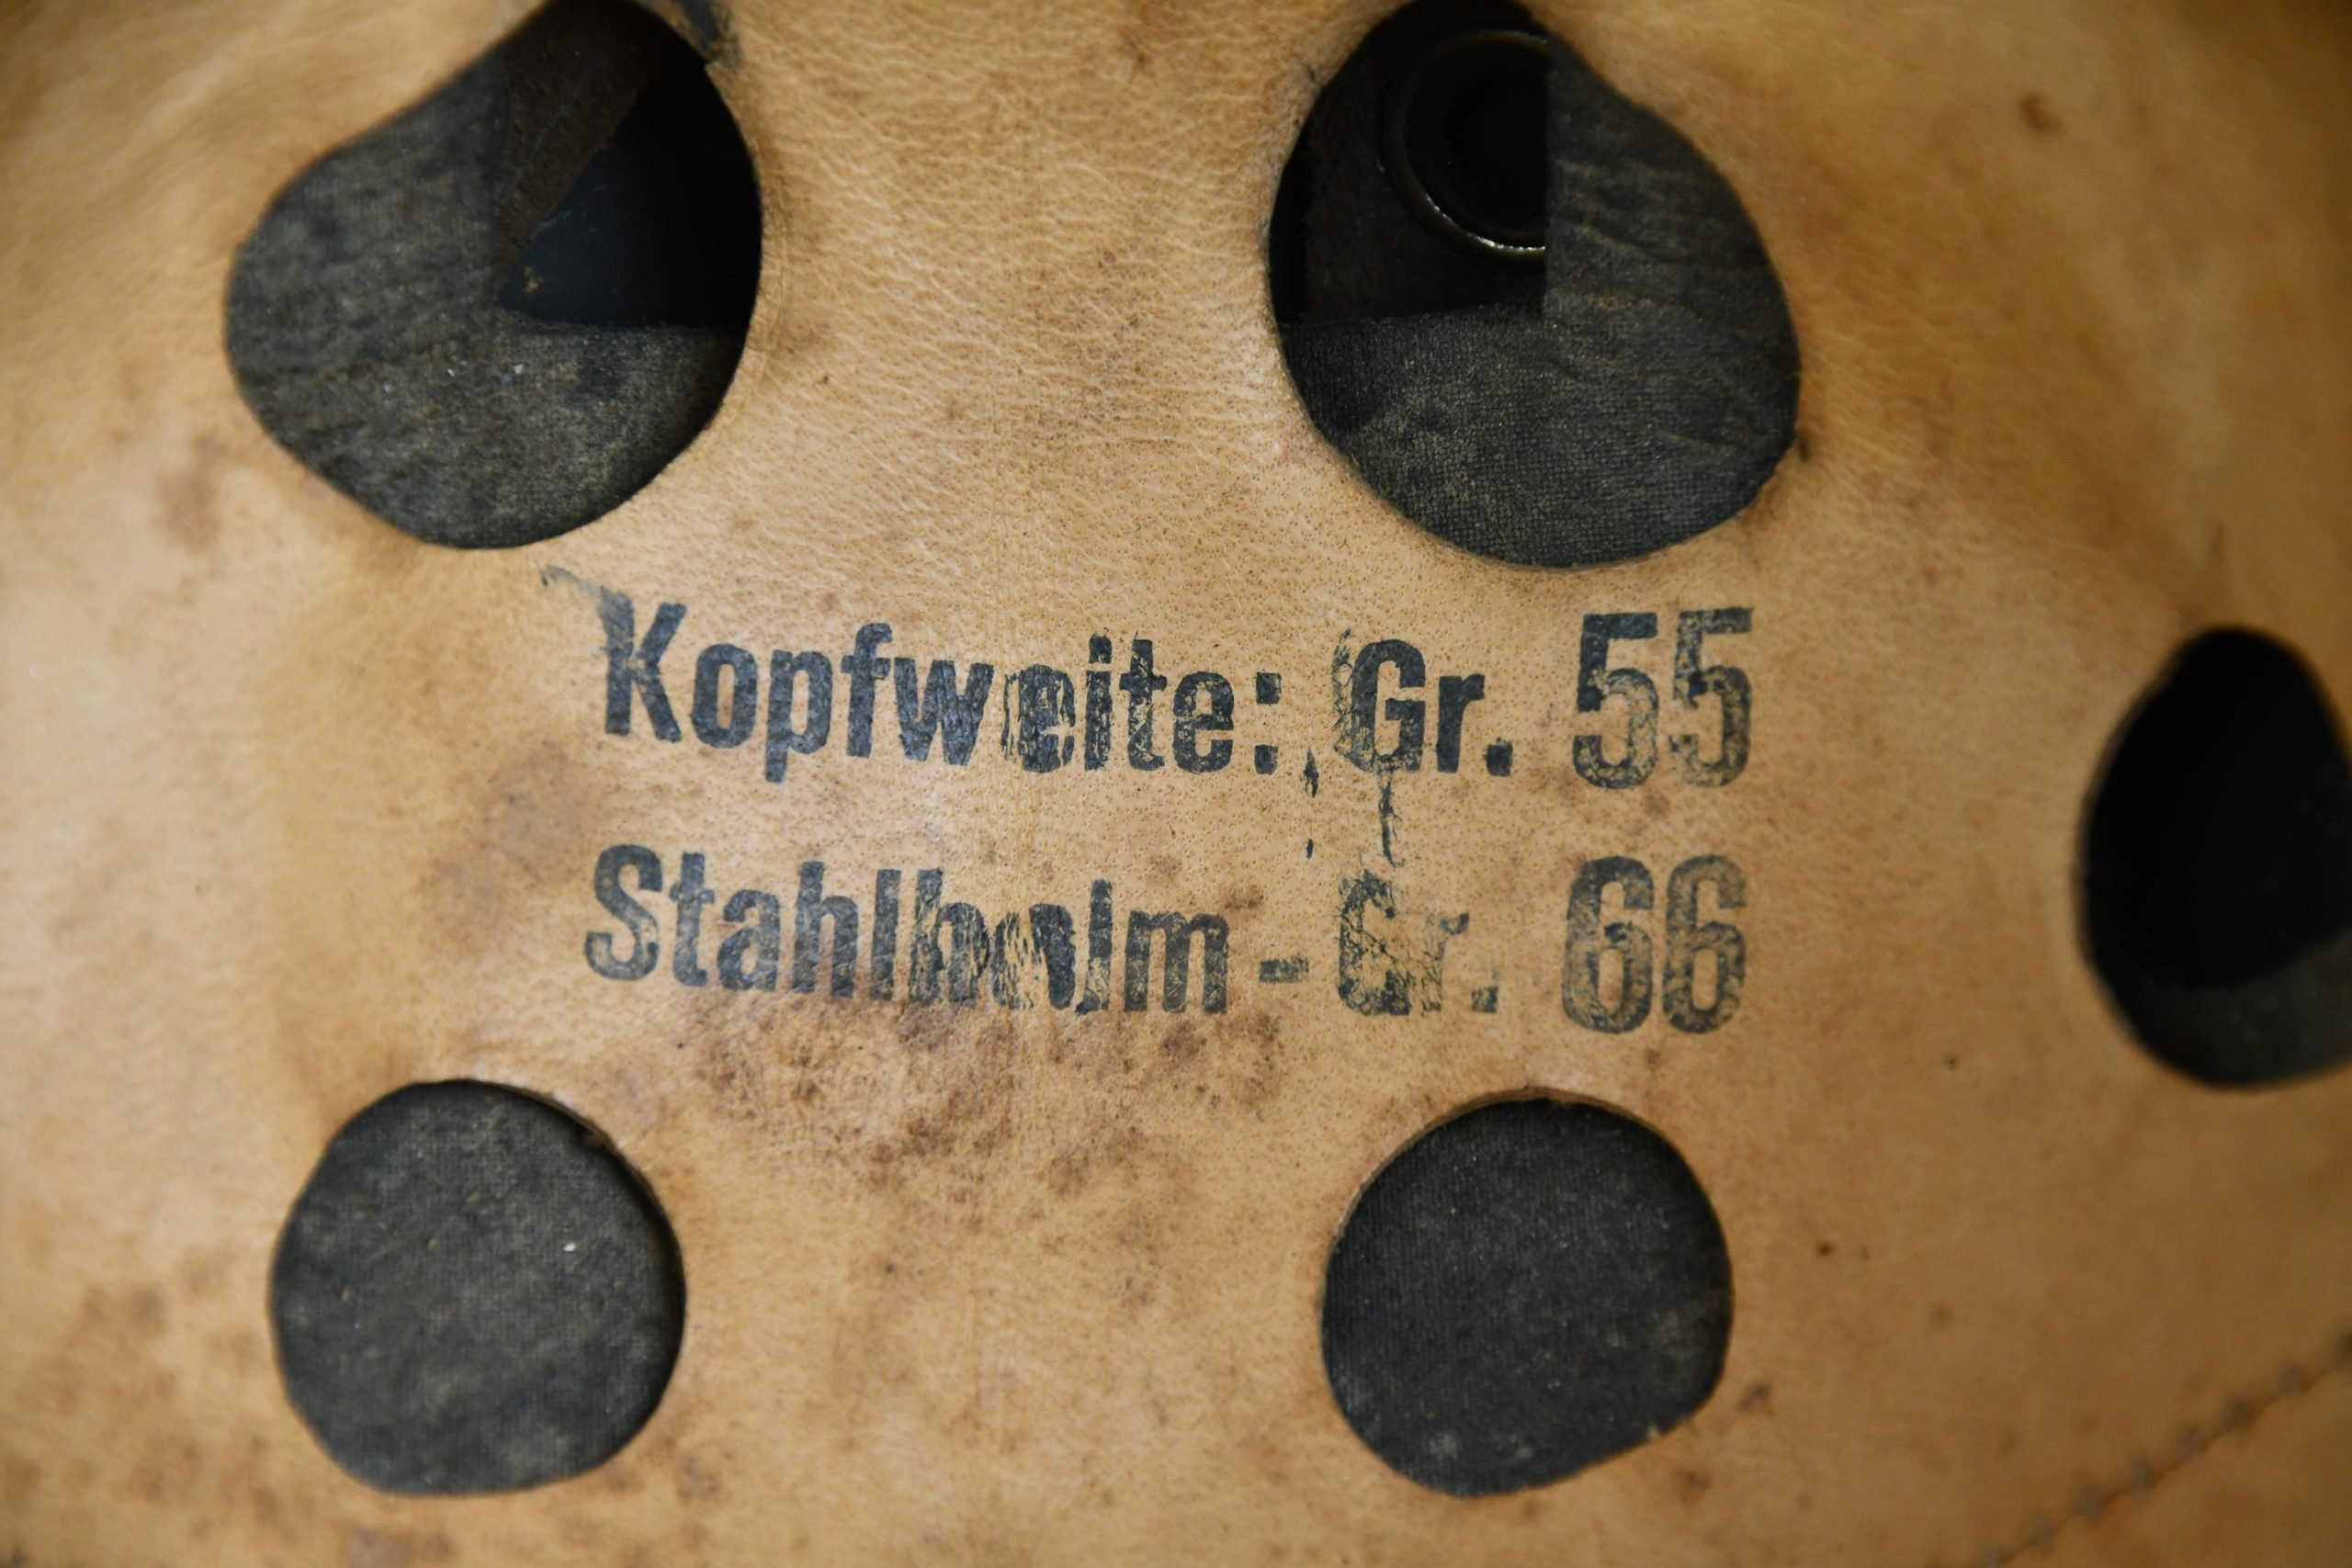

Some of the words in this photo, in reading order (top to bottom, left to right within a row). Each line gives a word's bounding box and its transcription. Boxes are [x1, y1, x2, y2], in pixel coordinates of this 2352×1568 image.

[601, 590, 1283, 783] Kopfweite:
[1335, 637, 1514, 777] Gr.
[1572, 607, 1753, 789] 55
[1564, 854, 1748, 1035] 66
